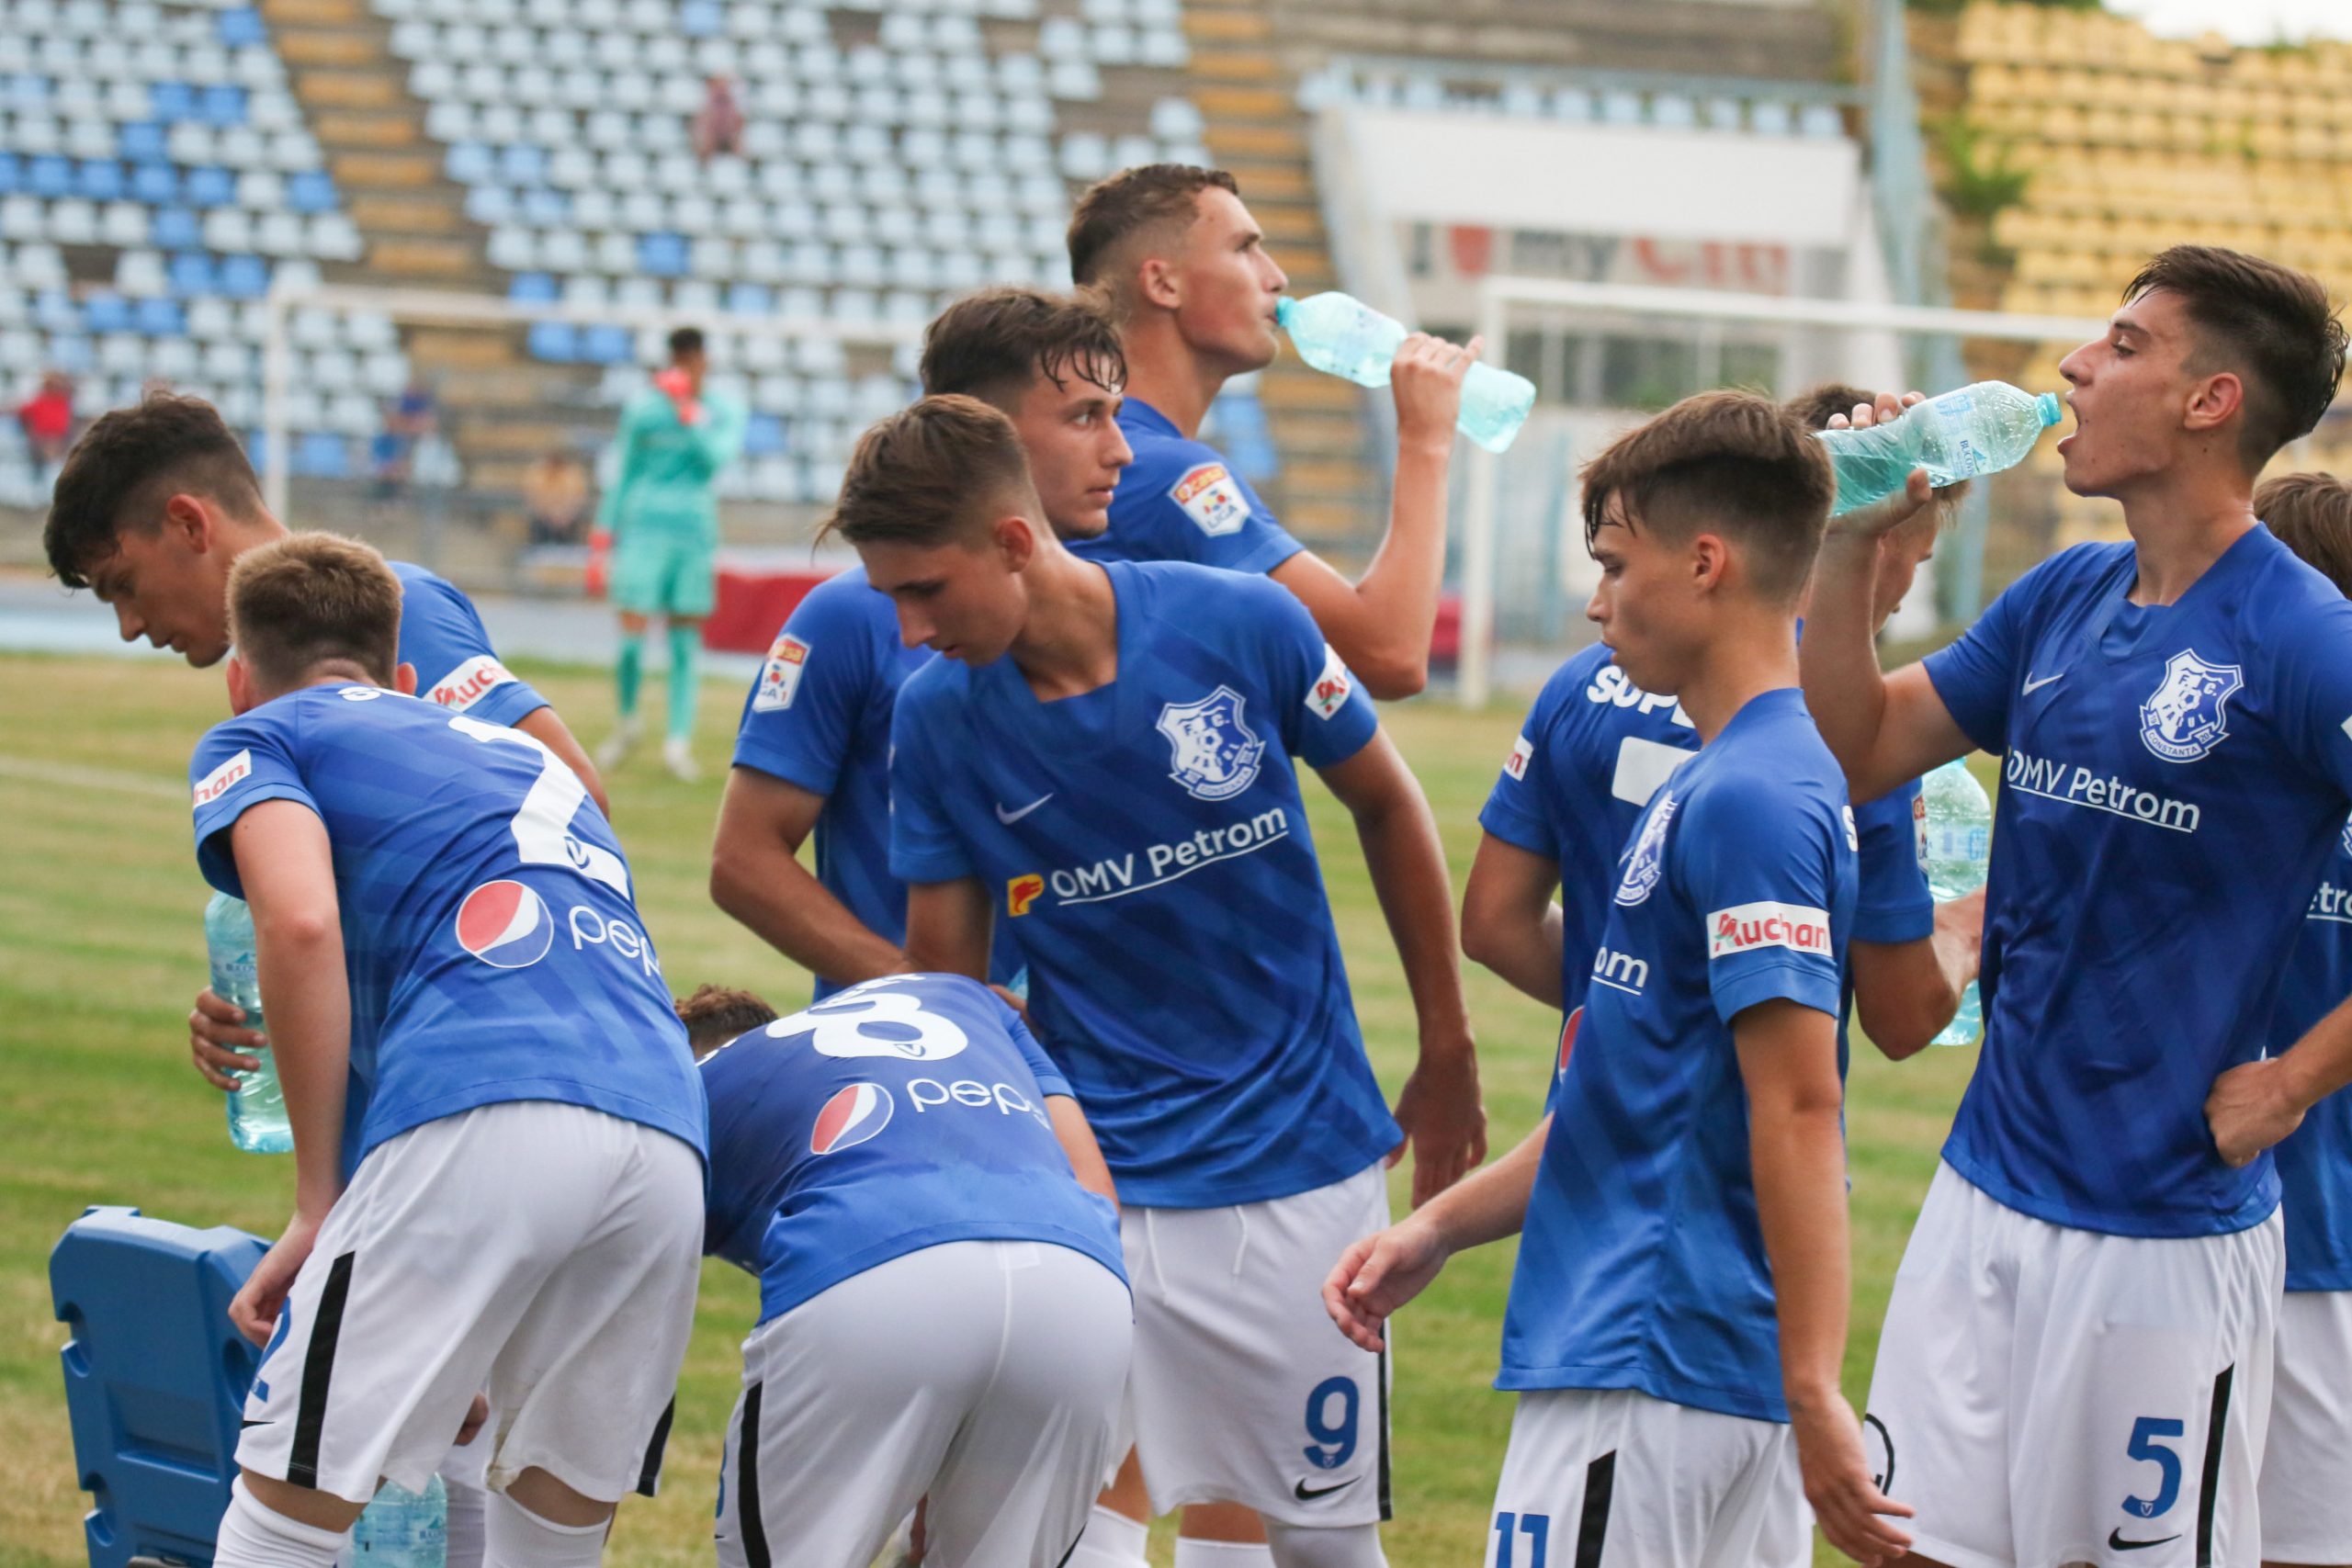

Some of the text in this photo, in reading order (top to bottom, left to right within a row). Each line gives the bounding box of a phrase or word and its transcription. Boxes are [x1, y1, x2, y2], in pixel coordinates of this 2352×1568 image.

[448, 716, 631, 900] 2
[2007, 750, 2200, 830] OMV Petrom
[1051, 807, 1286, 897] OMV Petrom
[569, 906, 661, 976] pep
[1714, 913, 1827, 952] Auchan
[765, 993, 968, 1061] 8
[1304, 1376, 1360, 1469] 9
[2121, 1416, 2184, 1518] 5
[1496, 1512, 1550, 1568] 11
